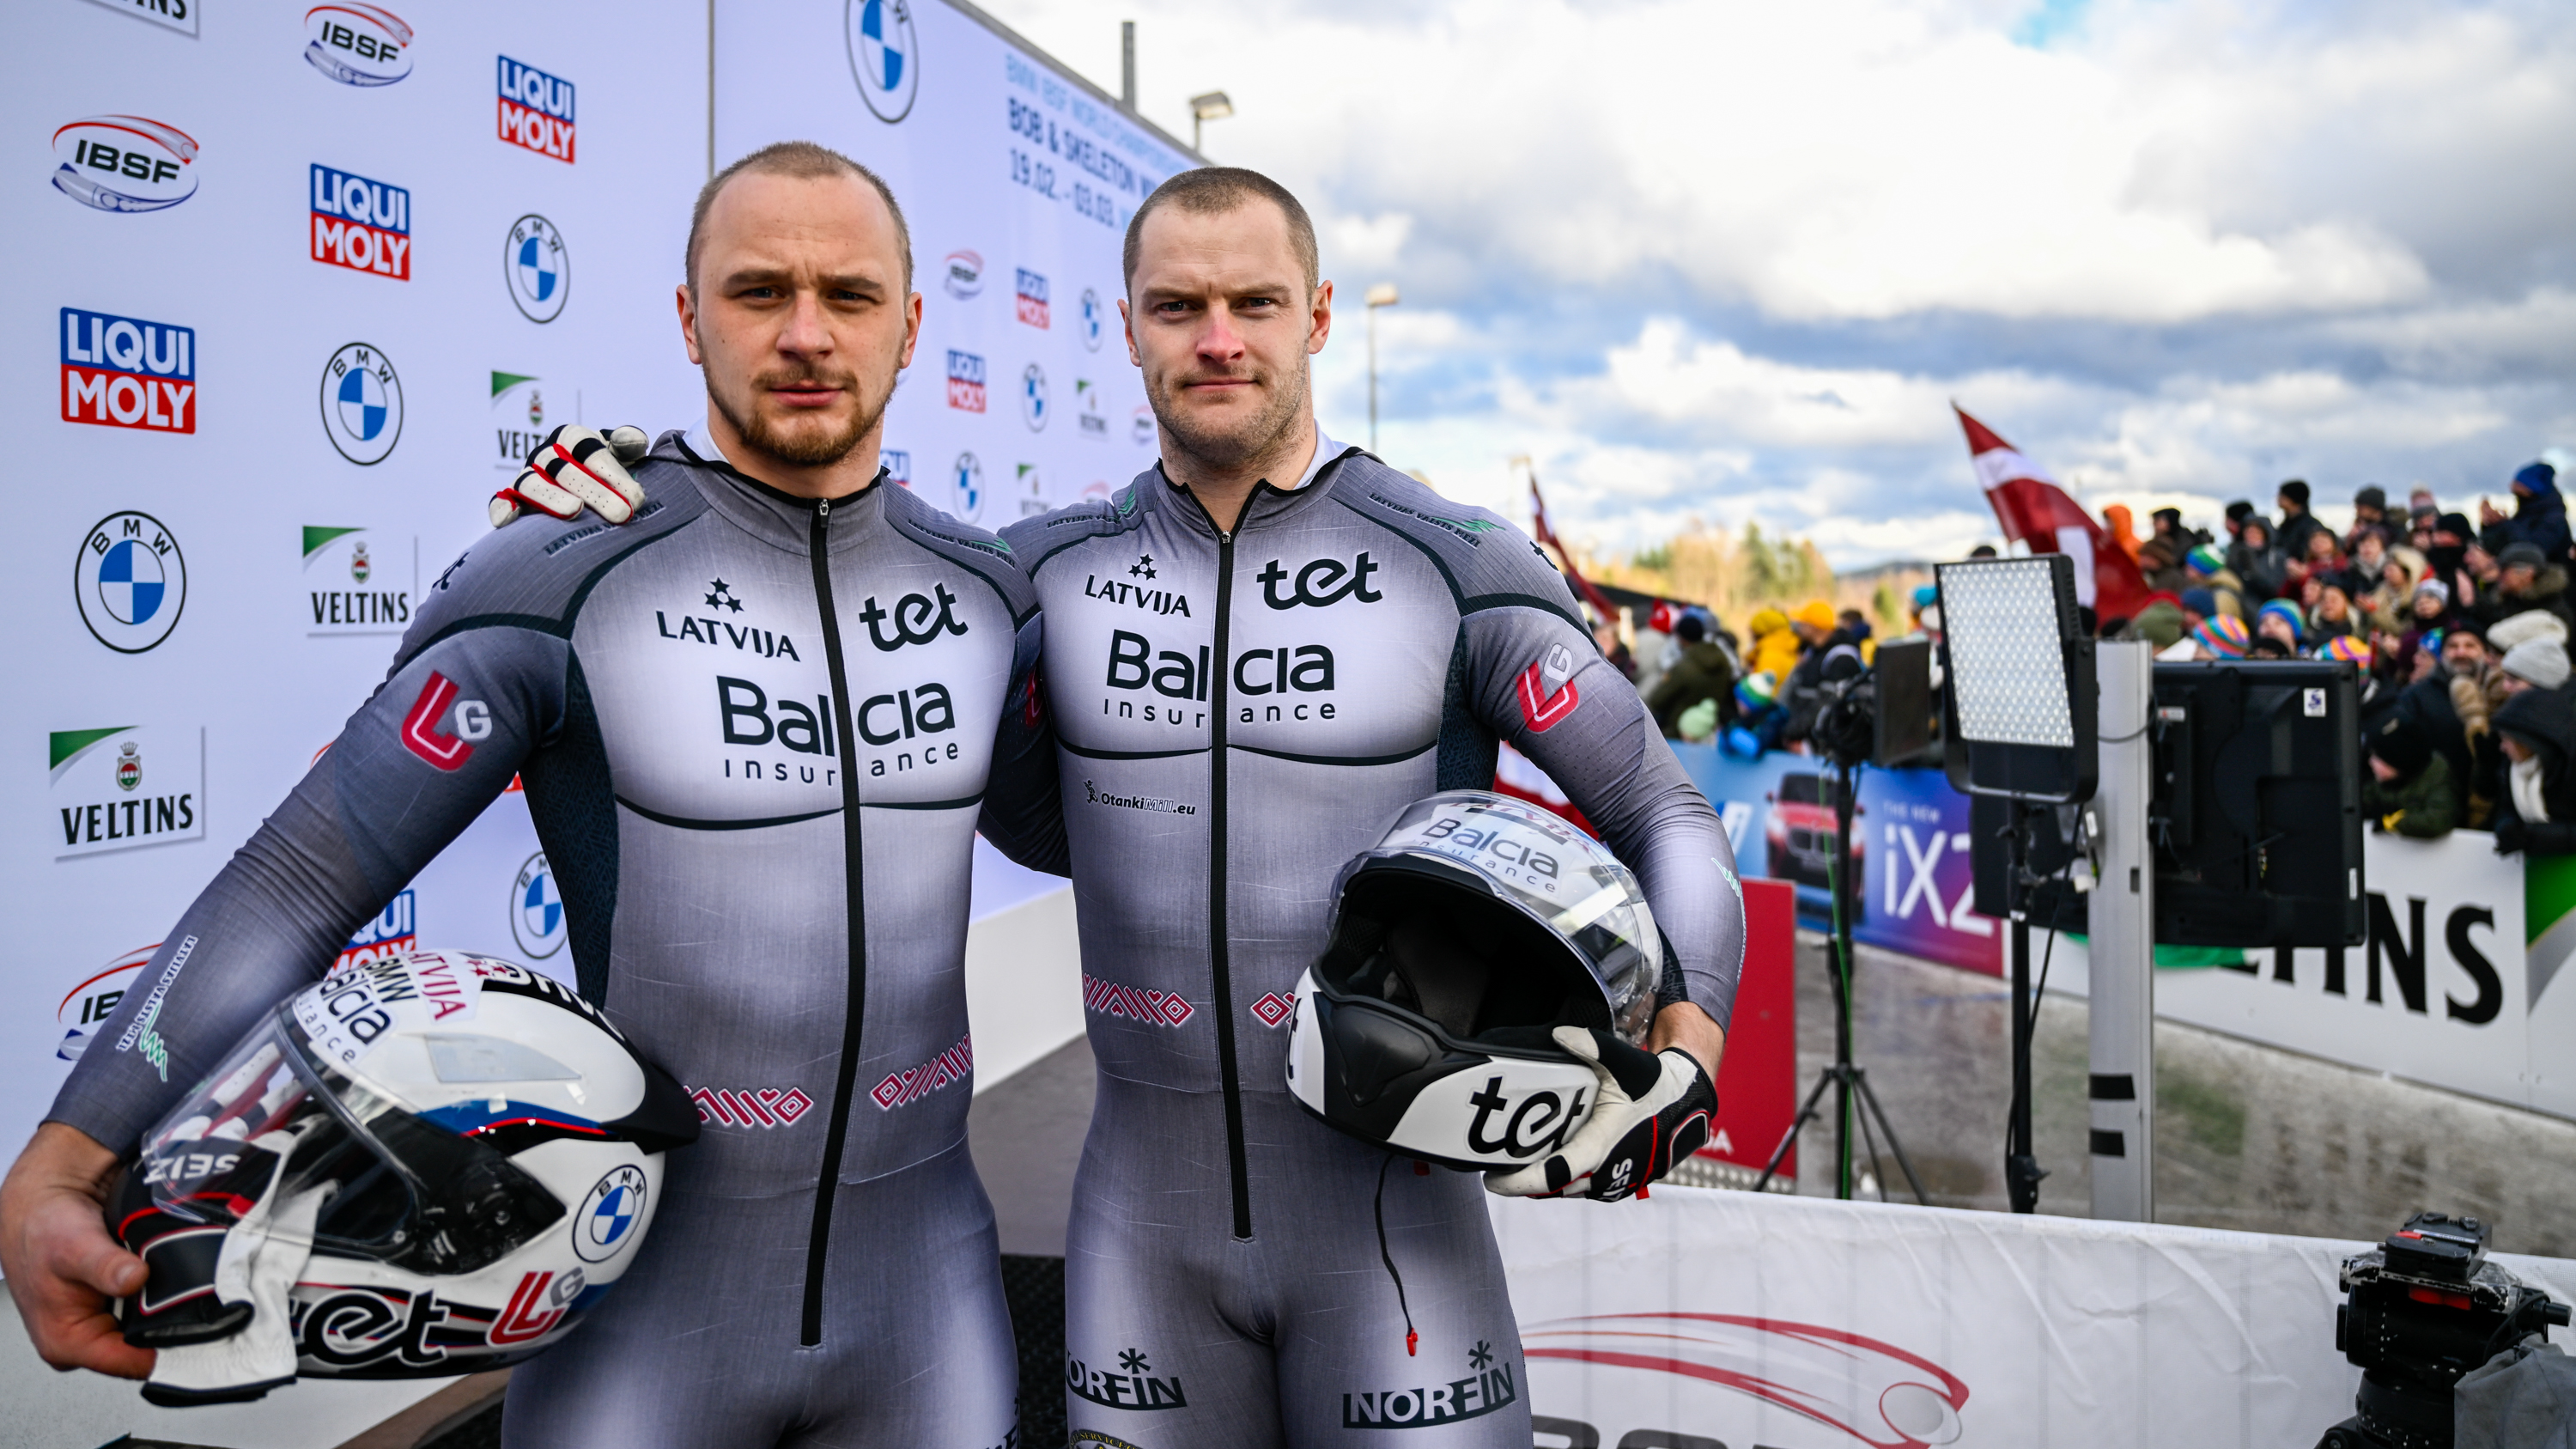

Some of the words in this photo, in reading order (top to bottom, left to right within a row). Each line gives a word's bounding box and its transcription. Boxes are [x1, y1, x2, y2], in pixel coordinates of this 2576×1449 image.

[321, 21, 399, 64] IBSF
[500, 56, 574, 119] LIQUI
[499, 96, 574, 161] MOLY
[1007, 96, 1043, 144] BOB
[1063, 129, 1136, 194] SKELETON
[75, 139, 179, 185] IBSF
[314, 169, 408, 231] LIQUI
[313, 216, 410, 278] MOLY
[514, 220, 562, 253] BMW
[66, 312, 191, 377] LIQUI
[333, 349, 392, 385] BMW
[66, 369, 194, 429] MOLY
[498, 429, 549, 460] VELT
[91, 519, 172, 556] BMW
[1084, 573, 1192, 619] LATVIJA
[1256, 550, 1383, 610] tet
[311, 590, 410, 625] VELTINS
[859, 581, 969, 653] tet
[654, 610, 801, 662] LATVIJA
[1106, 628, 1336, 702] Balcia
[715, 674, 957, 758] Balcia
[1103, 697, 1336, 729] insurance
[724, 741, 960, 787] insurance
[61, 793, 194, 845] VELTINS
[1101, 793, 1196, 816] OtankiMill.eu
[519, 858, 548, 889] BM
[1421, 818, 1560, 880] Balcia
[350, 890, 413, 943] QUI
[81, 989, 126, 1025] IB
[143, 1154, 242, 1184] SEIZ
[598, 1169, 645, 1197] BMW
[1066, 1354, 1188, 1411] ORFIN
[1343, 1361, 1516, 1429] NORFIN
